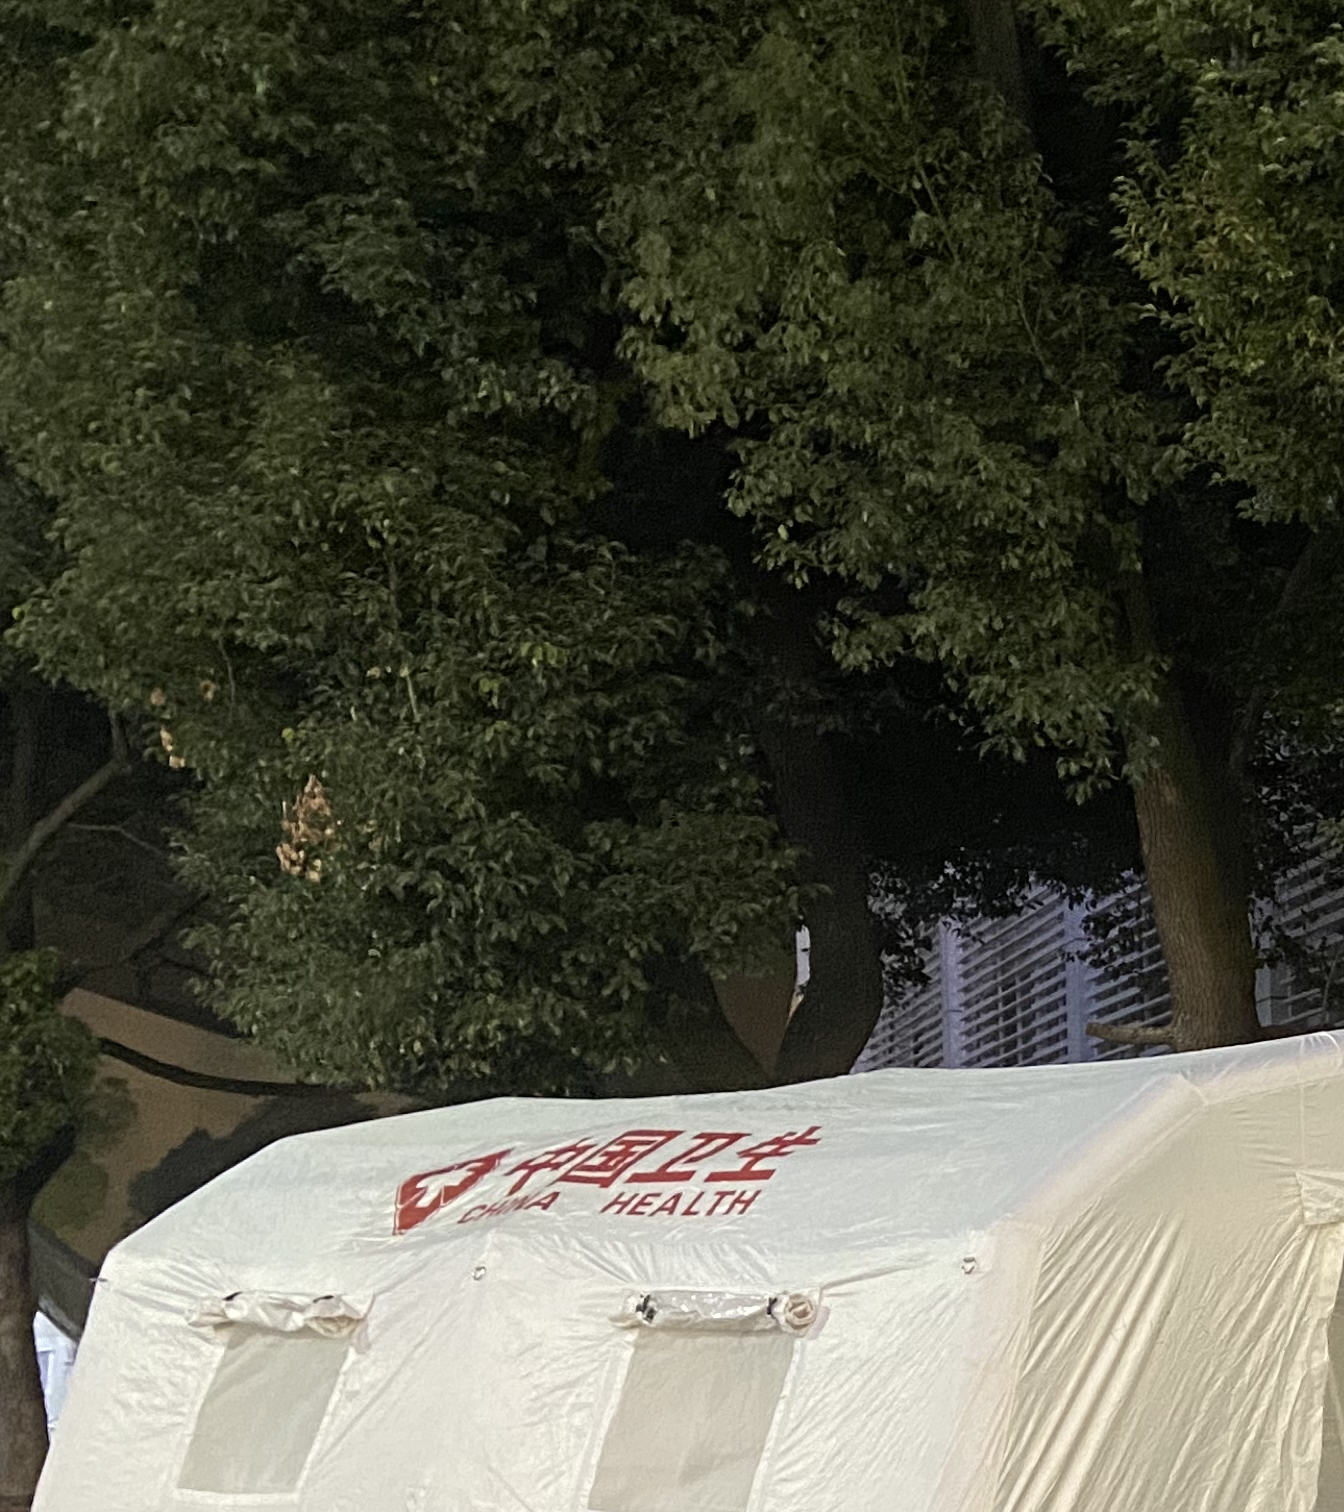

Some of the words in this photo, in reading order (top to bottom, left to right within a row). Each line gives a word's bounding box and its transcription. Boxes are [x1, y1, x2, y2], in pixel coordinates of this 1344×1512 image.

[504, 1126, 822, 1195] 中国卫生
[457, 1191, 561, 1224] CHINA
[599, 1189, 762, 1217] HEALTH
